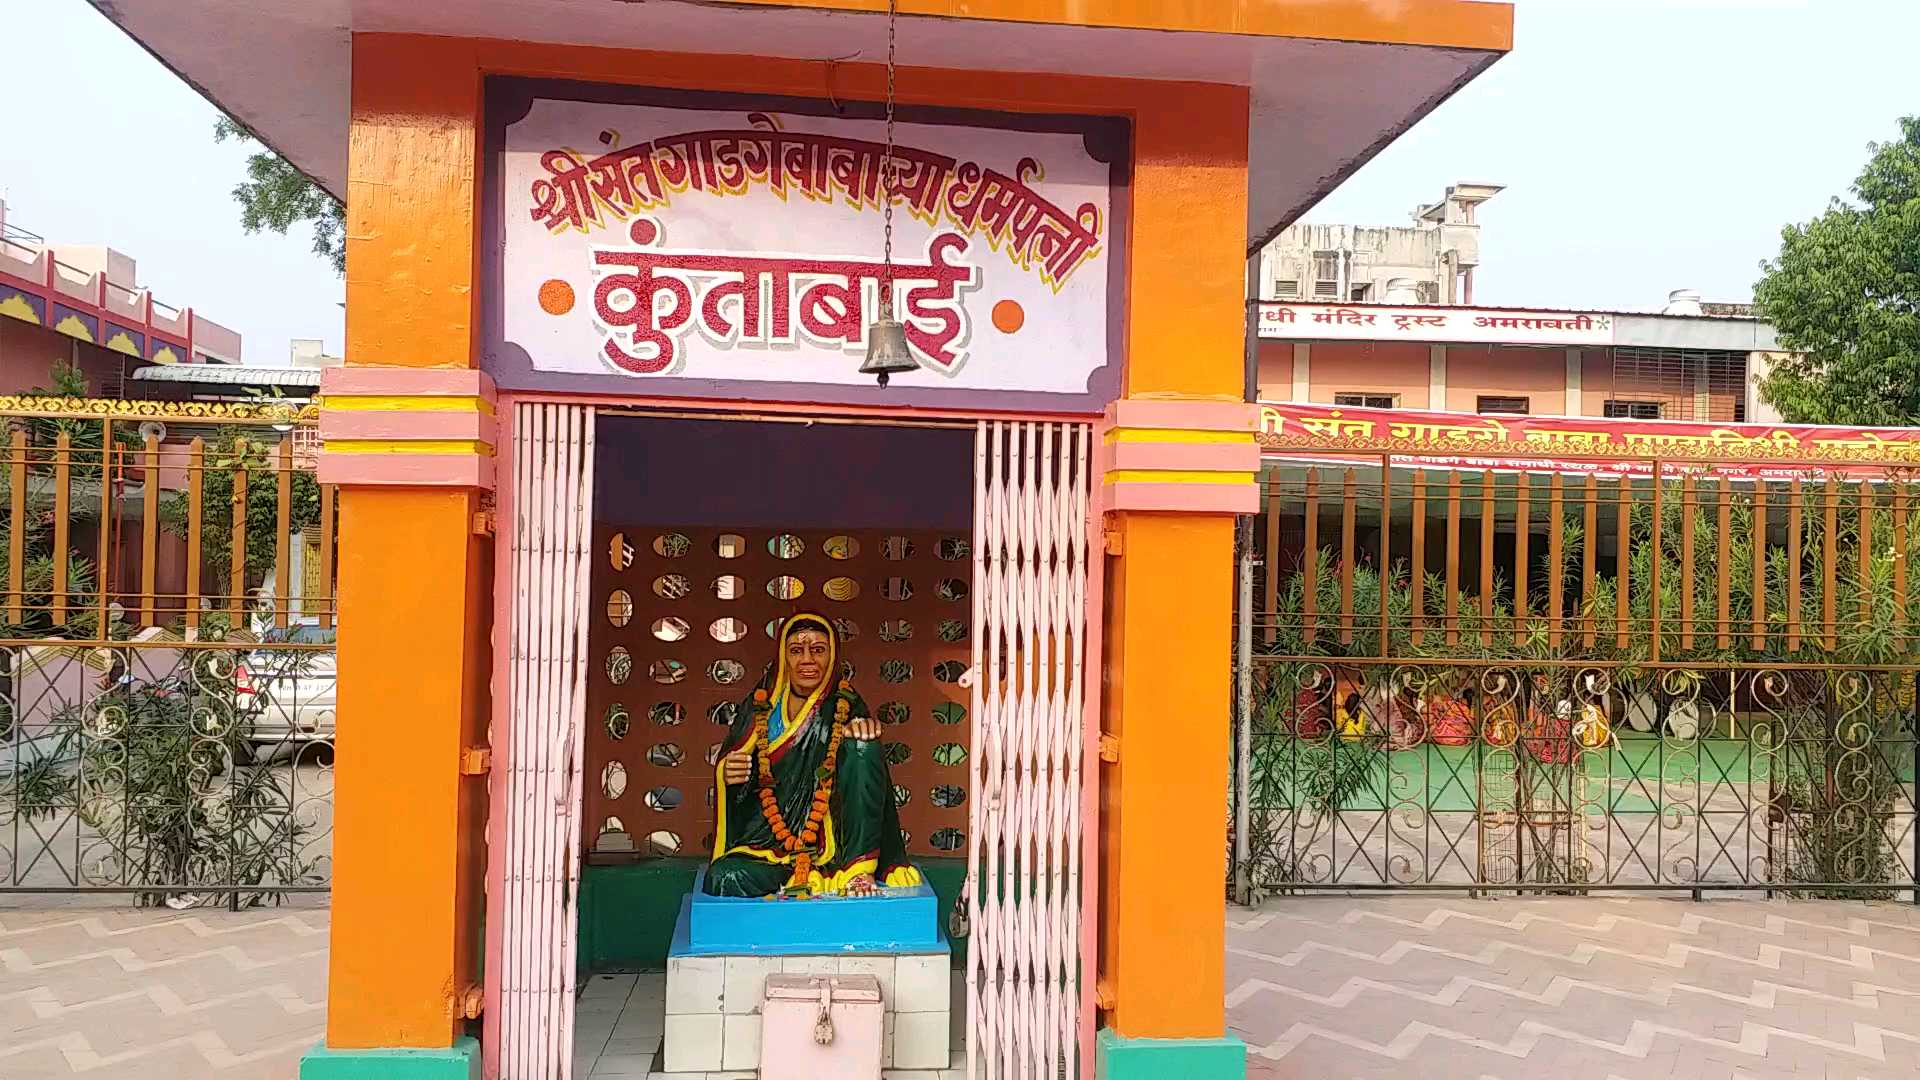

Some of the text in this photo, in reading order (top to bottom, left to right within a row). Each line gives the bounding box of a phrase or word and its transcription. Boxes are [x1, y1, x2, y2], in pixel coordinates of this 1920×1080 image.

[530, 150, 600, 231] श्री
[1312, 309, 1377, 326] मंदिर
[1473, 315, 1594, 330] अमरावती
